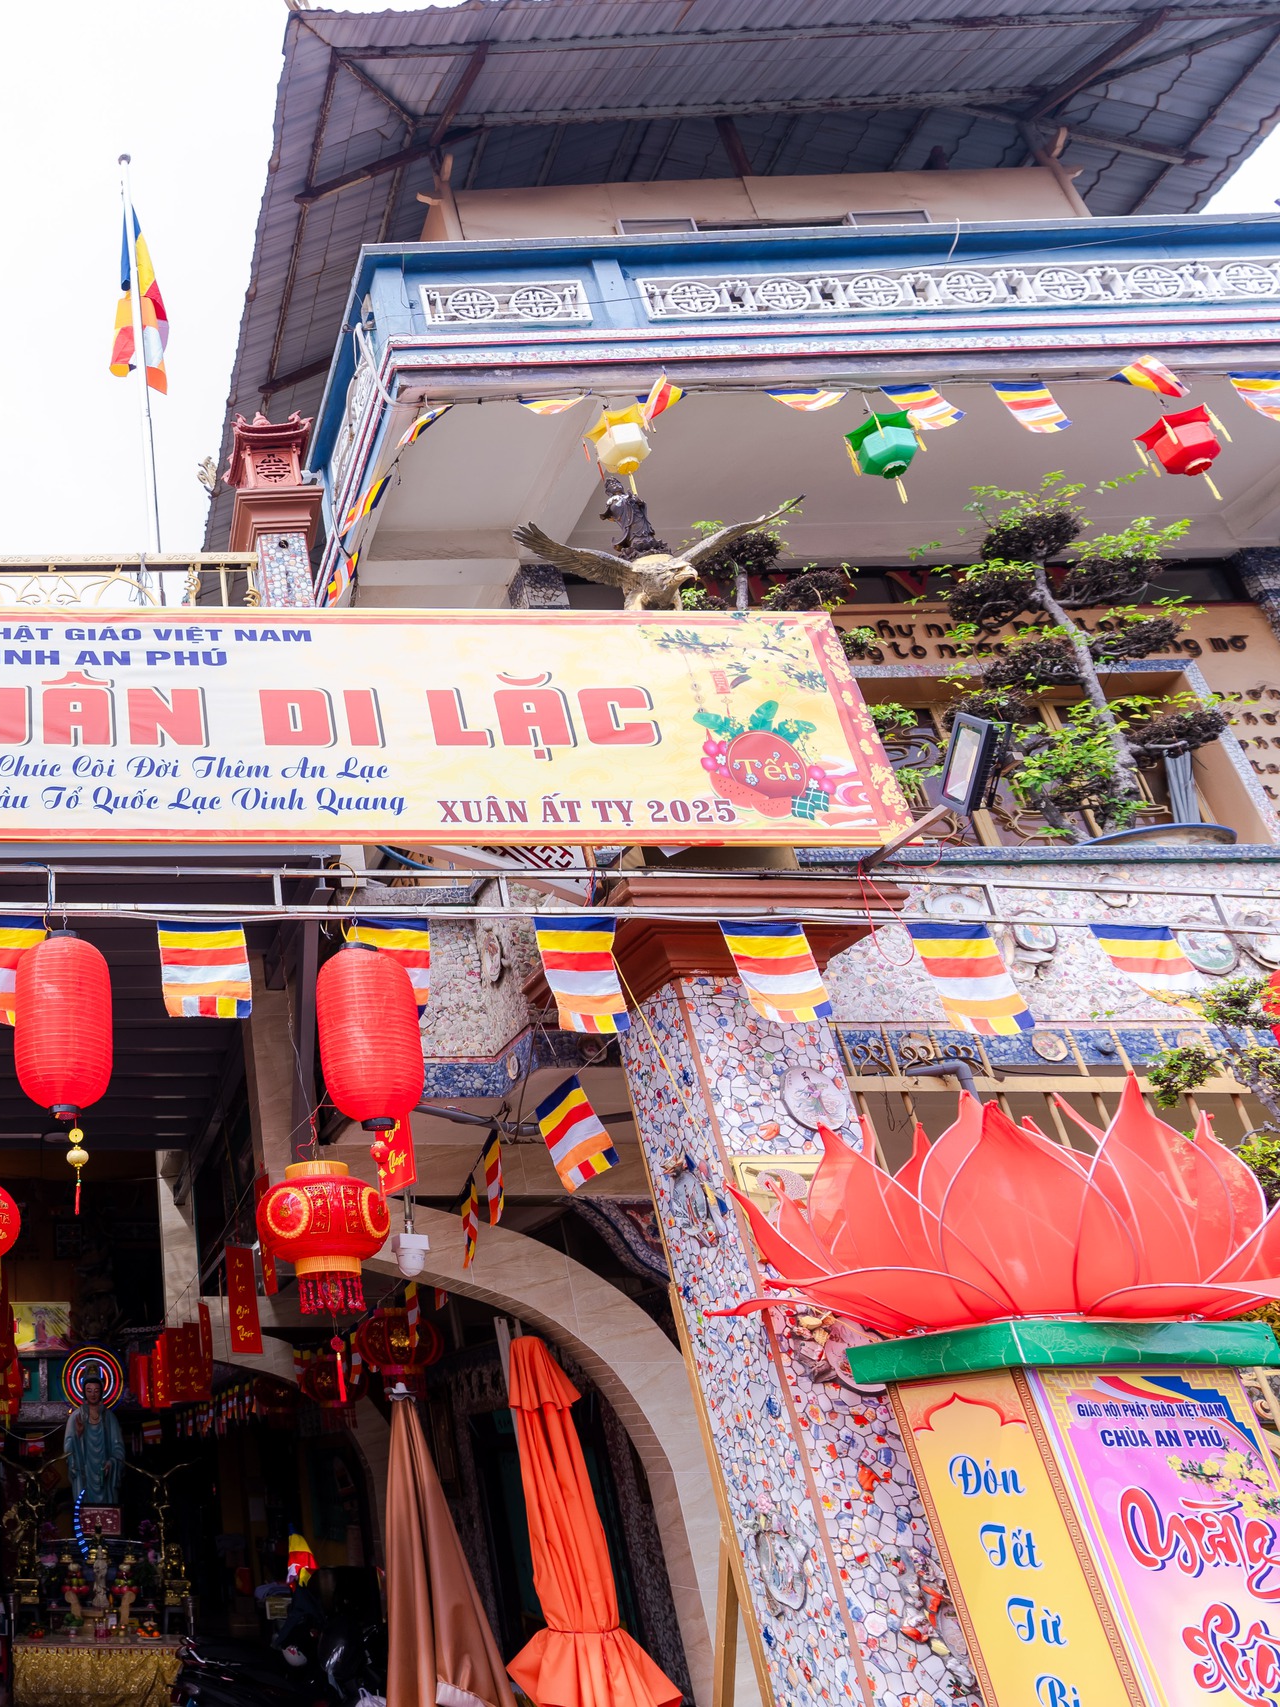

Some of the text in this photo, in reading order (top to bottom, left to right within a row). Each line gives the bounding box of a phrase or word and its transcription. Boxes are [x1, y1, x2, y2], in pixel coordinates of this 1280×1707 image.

[64, 625, 142, 641] GIÁO
[153, 626, 223, 645] VIỆT
[234, 629, 312, 642] NAM
[75, 650, 132, 666] AN
[145, 646, 228, 667] PHÚ
[259, 688, 383, 748] DI
[426, 674, 659, 760] LẶC
[71, 754, 116, 778] Cõi
[126, 756, 180, 779] Đời
[191, 755, 270, 779] Thêm
[280, 756, 326, 779] An
[336, 757, 390, 784] Lạc
[734, 756, 798, 782] Tết
[41, 785, 84, 810] Tổ
[91, 786, 159, 815] Quốc
[166, 787, 222, 815] Lạc
[230, 787, 307, 812] Vinh
[314, 787, 408, 817] Quang
[439, 793, 736, 827] XUÂN ẤT TỴ 2025
[1077, 1403, 1227, 1418] GIÁO HỘI PHẬT GIÁO VIỆT NAM
[1100, 1426, 1223, 1447] CHÙA AN PHÚ
[948, 1455, 1025, 1496] Đón
[979, 1523, 1042, 1569] Tết
[1007, 1597, 1067, 1646] Từ
